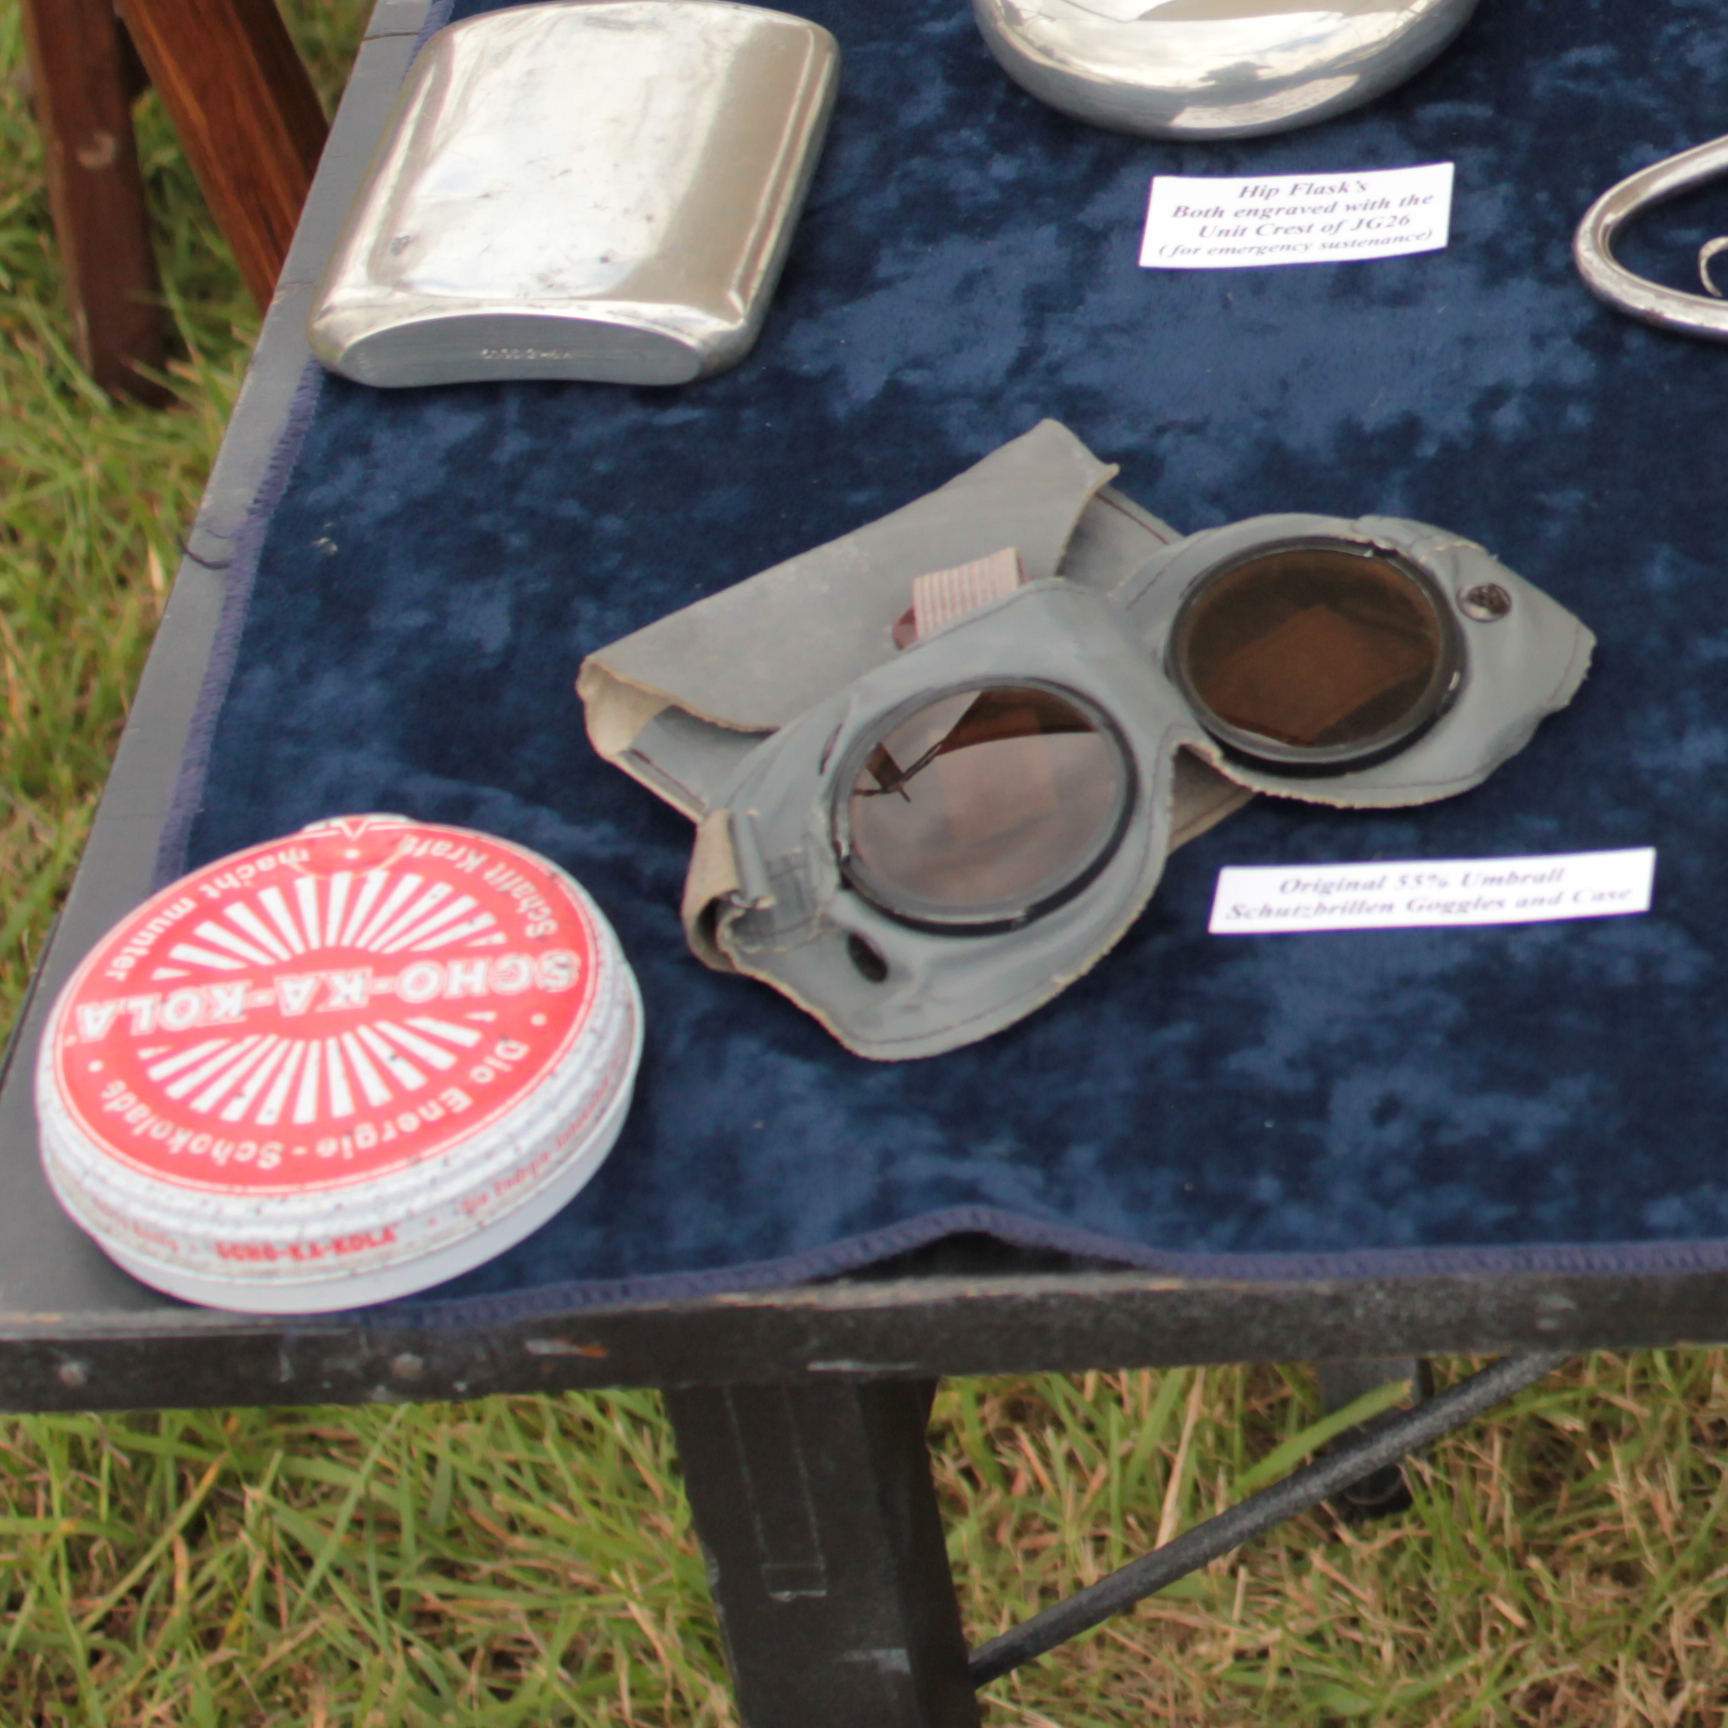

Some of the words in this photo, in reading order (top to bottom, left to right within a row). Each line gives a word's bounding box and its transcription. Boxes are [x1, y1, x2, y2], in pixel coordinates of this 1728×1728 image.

[1238, 185, 1281, 200] Hip
[1172, 205, 1225, 218] Both
[1233, 201, 1338, 219] engraved
[1345, 198, 1391, 212] with
[1398, 194, 1434, 208] the
[1198, 225, 1248, 238] Unit
[1255, 223, 1315, 236] Crest
[1320, 219, 1348, 235] of
[1351, 214, 1411, 231] JG26
[1169, 244, 1202, 258] for
[1207, 242, 1313, 256] emergency
[398, 834, 488, 877] Kraft
[197, 844, 312, 901] macht
[1279, 875, 1387, 896] Original
[490, 864, 559, 941] Schafft
[111, 897, 197, 983] munter
